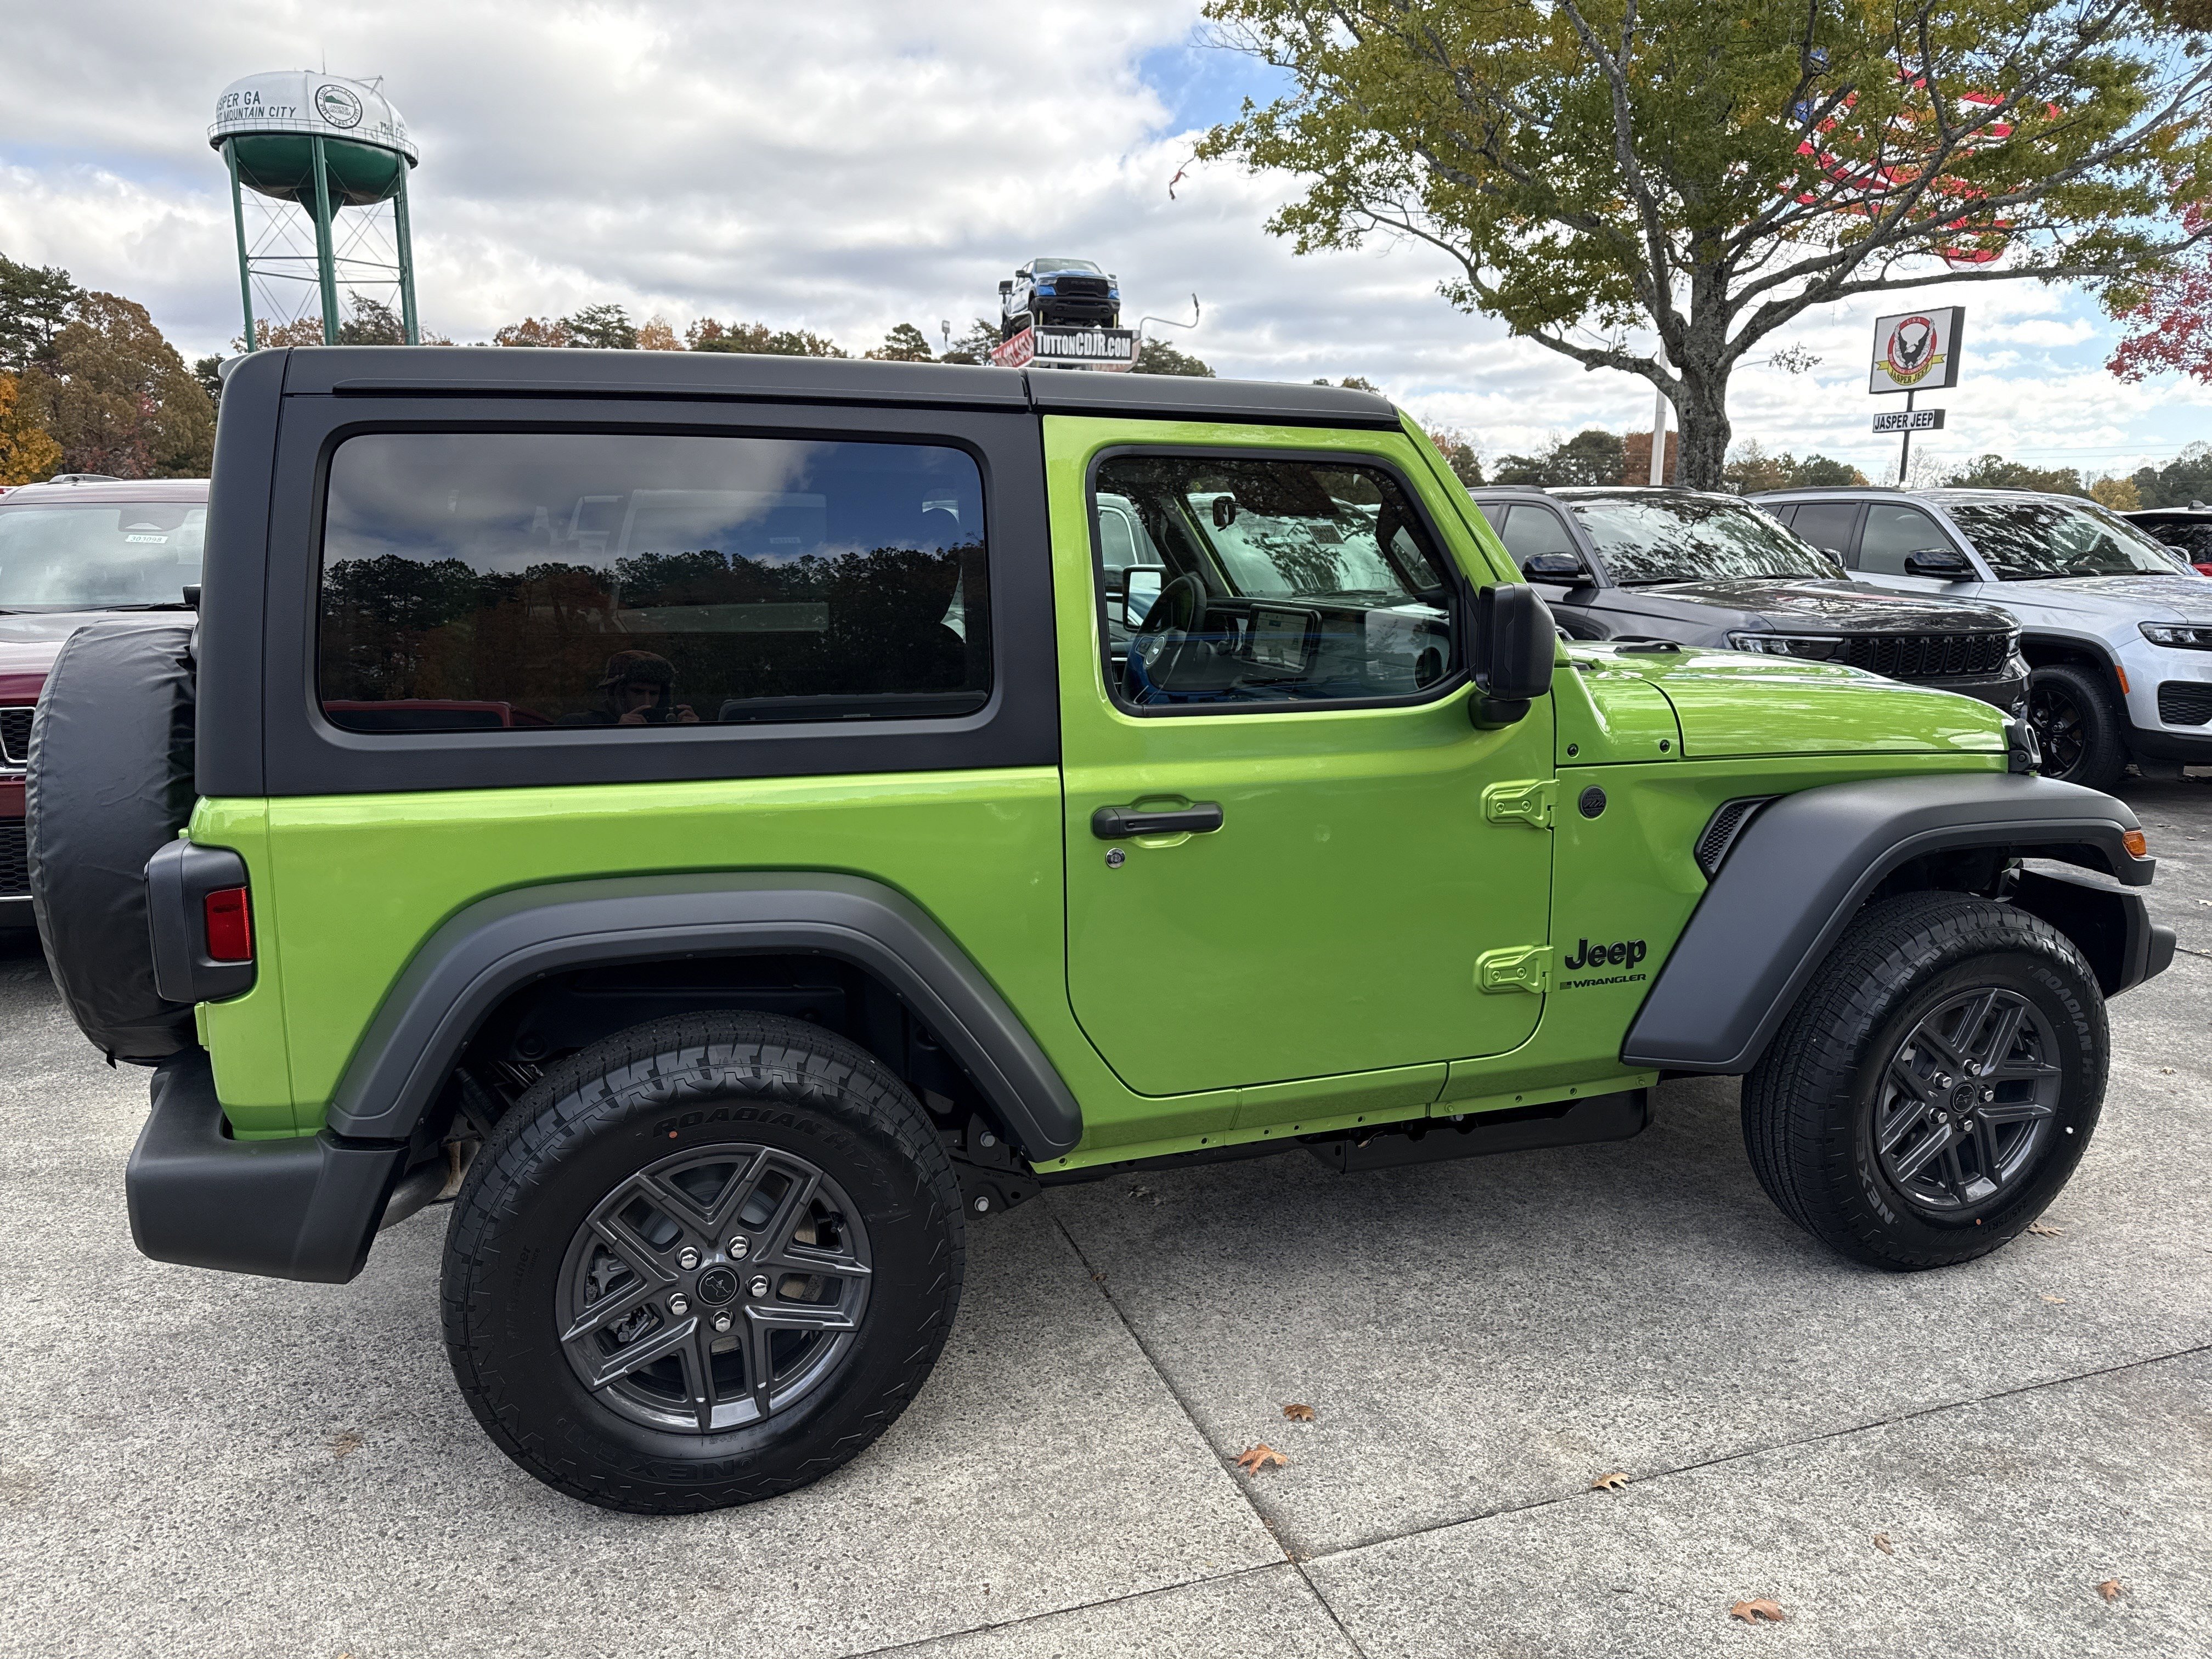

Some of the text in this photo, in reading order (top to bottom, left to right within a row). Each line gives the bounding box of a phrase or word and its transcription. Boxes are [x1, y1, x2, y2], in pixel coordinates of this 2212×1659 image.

[244, 91, 261, 105] GA
[224, 106, 265, 121] MOUNTAIN
[269, 106, 297, 118] CITY
[1890, 364, 1929, 383] JASPER JEEP
[1875, 412, 1933, 430] JASPER JEEP
[1565, 937, 1646, 970] Jeep
[1572, 973, 1646, 988] WRANGLER
[2032, 968, 2092, 1051] ROADIAN
[653, 1107, 823, 1139] ROADIAN
[564, 1423, 735, 1481] NEXEN
